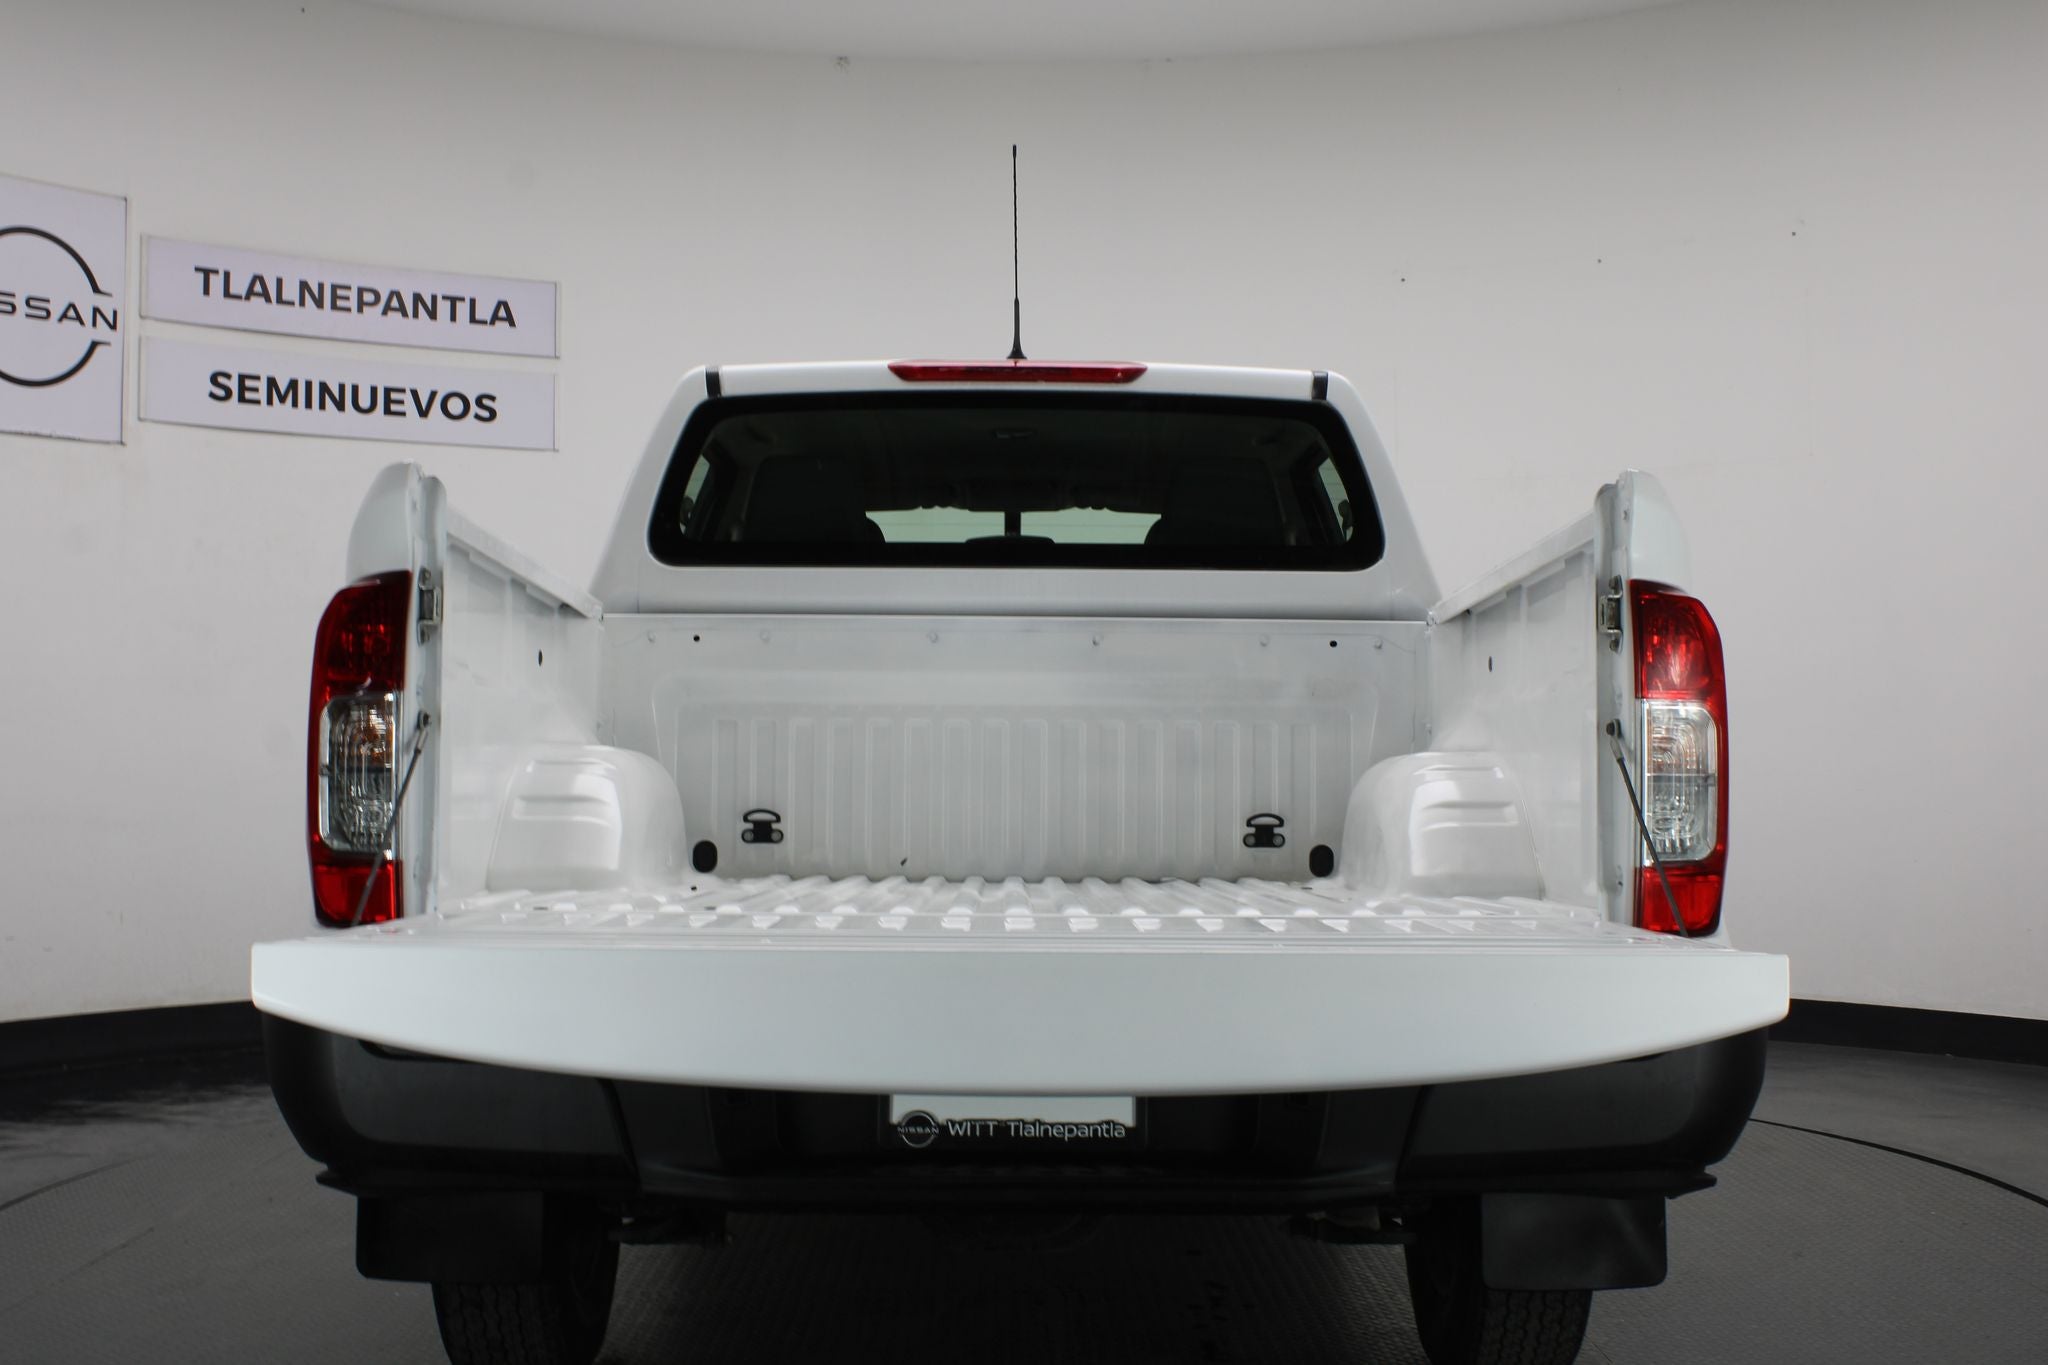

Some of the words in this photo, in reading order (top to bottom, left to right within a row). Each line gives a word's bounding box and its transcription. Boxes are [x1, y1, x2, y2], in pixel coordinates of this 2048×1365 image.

[194, 265, 518, 329] TLALNEPANTLA
[207, 371, 499, 423] SEMINUEVOS
[948, 1120, 998, 1138] WITT
[1008, 1120, 1126, 1142] Tlalnepantla
